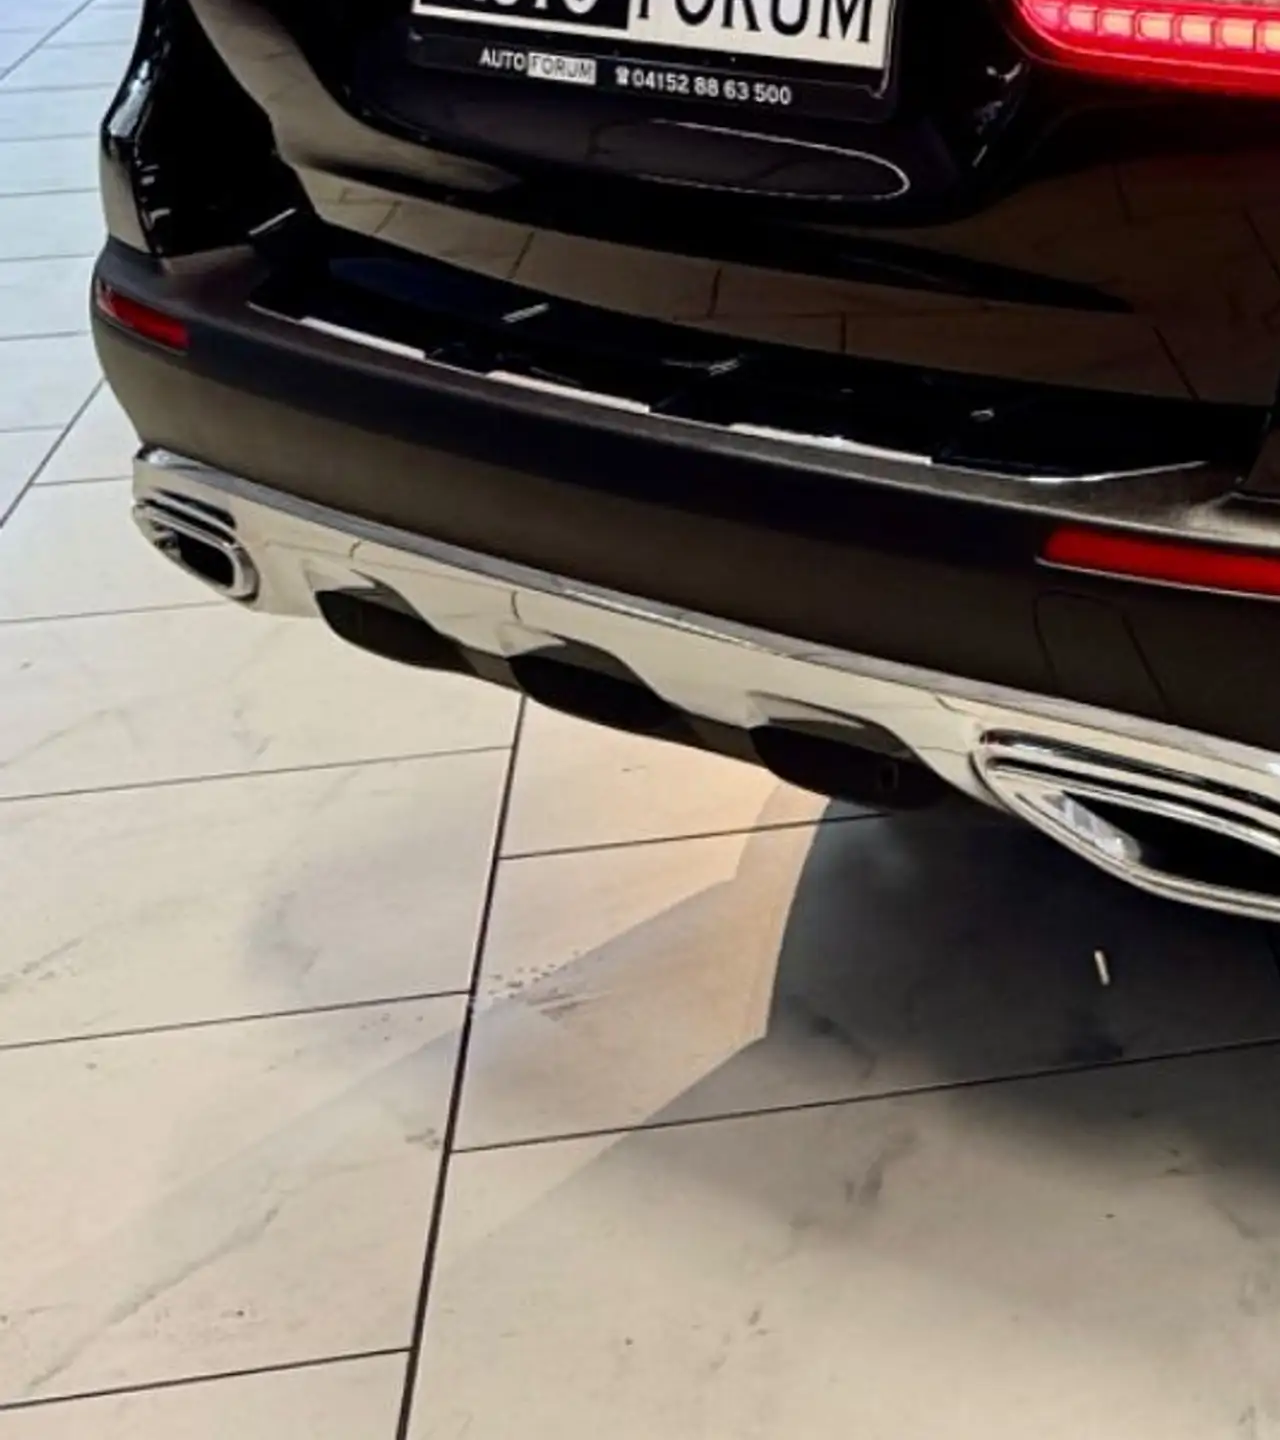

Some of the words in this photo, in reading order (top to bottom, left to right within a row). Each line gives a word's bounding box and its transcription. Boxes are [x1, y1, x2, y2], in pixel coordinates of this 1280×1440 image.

[480, 48, 525, 71] AUTO
[529, 55, 595, 82] FORUM
[631, 69, 690, 95] 04152
[694, 76, 719, 98] 88
[724, 79, 749, 101] 63
[753, 84, 792, 105] 500
